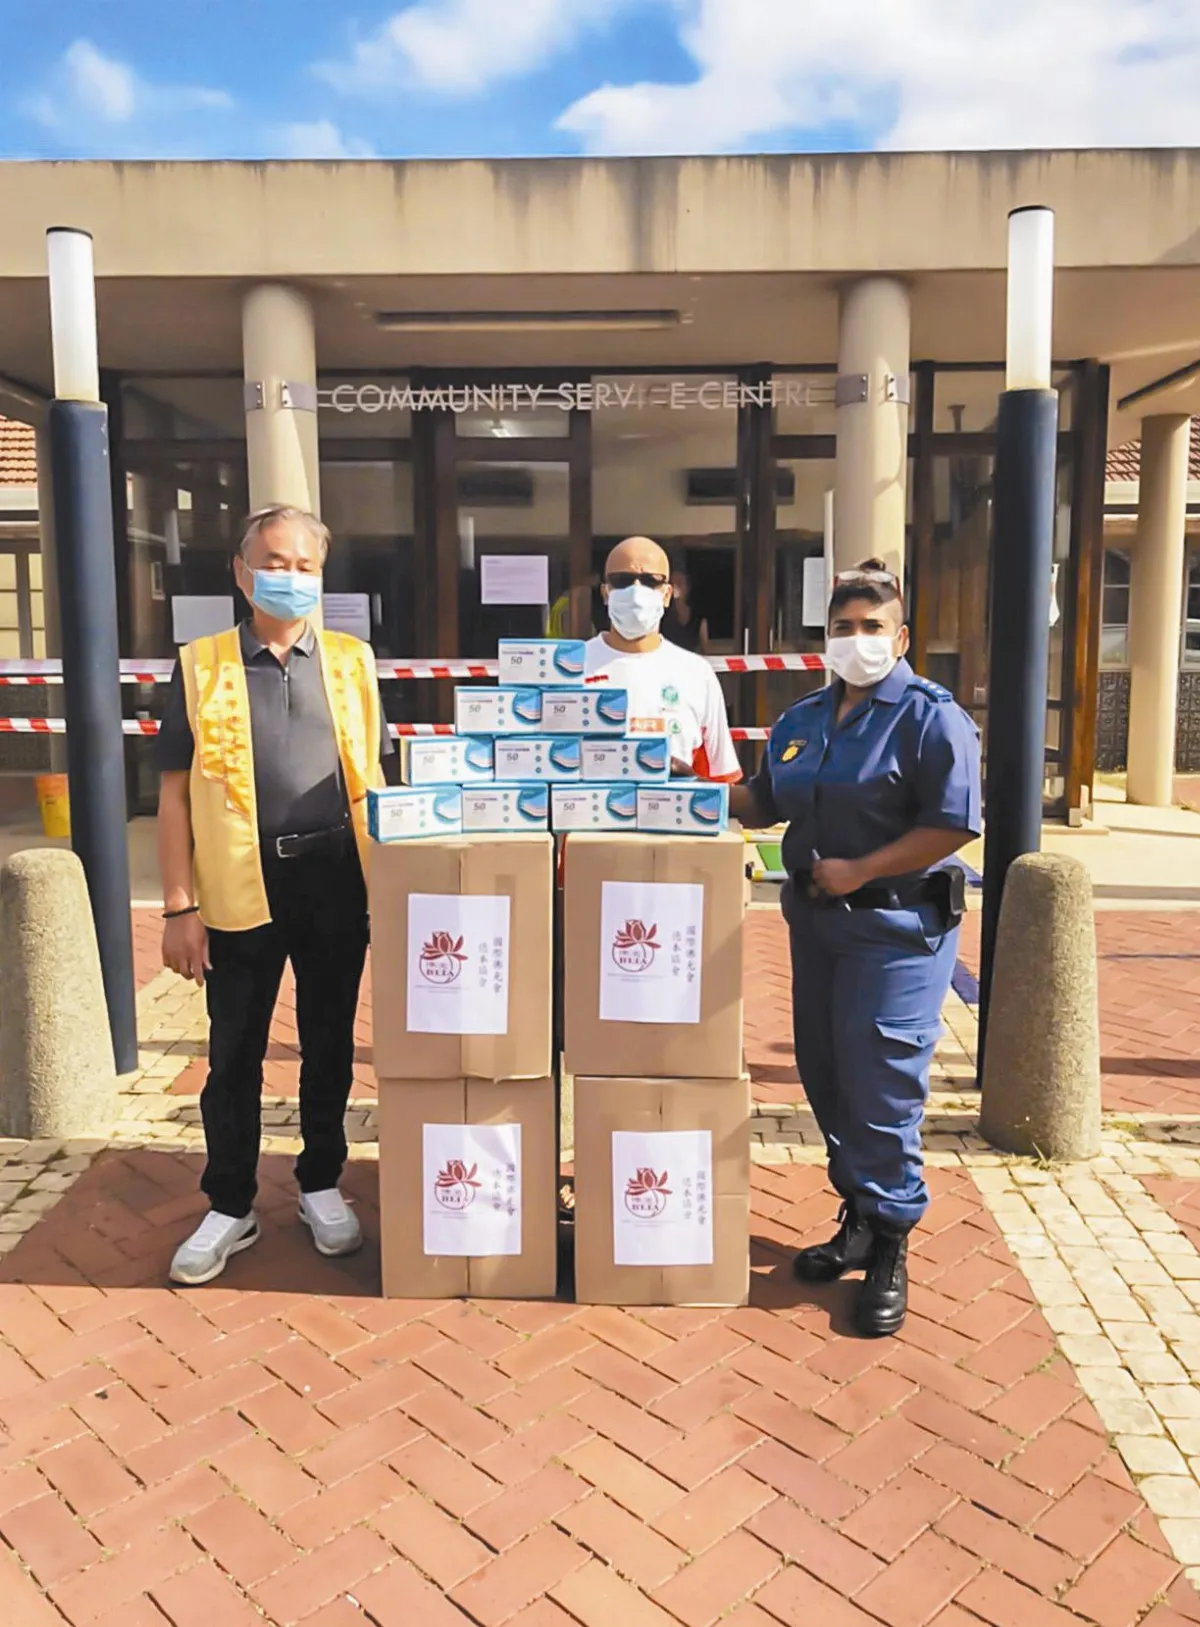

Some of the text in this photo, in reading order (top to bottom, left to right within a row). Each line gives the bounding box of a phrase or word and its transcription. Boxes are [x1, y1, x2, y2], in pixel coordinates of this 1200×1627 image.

[331, 384, 544, 413] COMMUNITY
[698, 380, 821, 410] CENTRE
[510, 656, 523, 665] 50
[469, 704, 482, 713] 50
[553, 705, 566, 714] 50
[506, 753, 519, 762] 50
[594, 753, 606, 762] 50
[473, 802, 487, 811] 50
[563, 803, 576, 811] 50
[647, 802, 660, 811] 50
